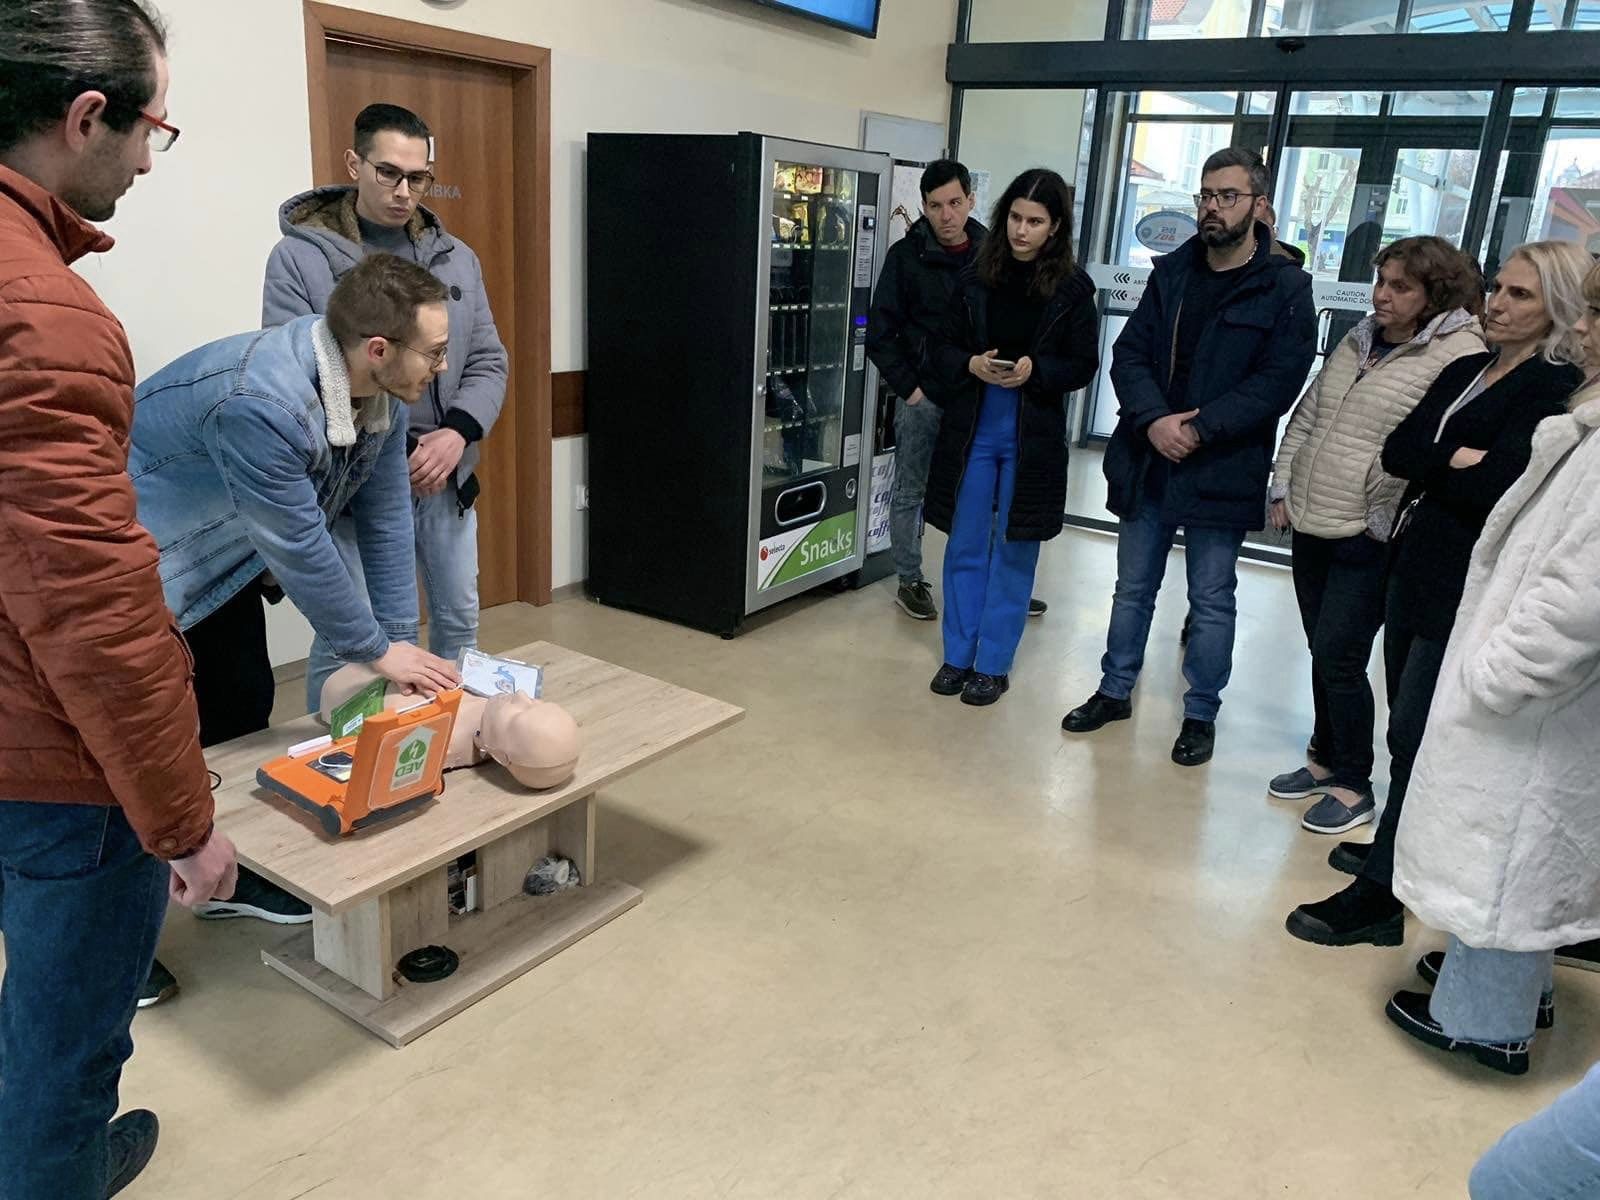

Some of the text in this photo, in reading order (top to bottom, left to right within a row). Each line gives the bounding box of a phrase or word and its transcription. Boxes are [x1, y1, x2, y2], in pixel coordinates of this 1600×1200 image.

[1336, 289, 1366, 297] CAUTION
[1320, 295, 1357, 303] AUTOMATIC
[800, 528, 853, 566] Snacks
